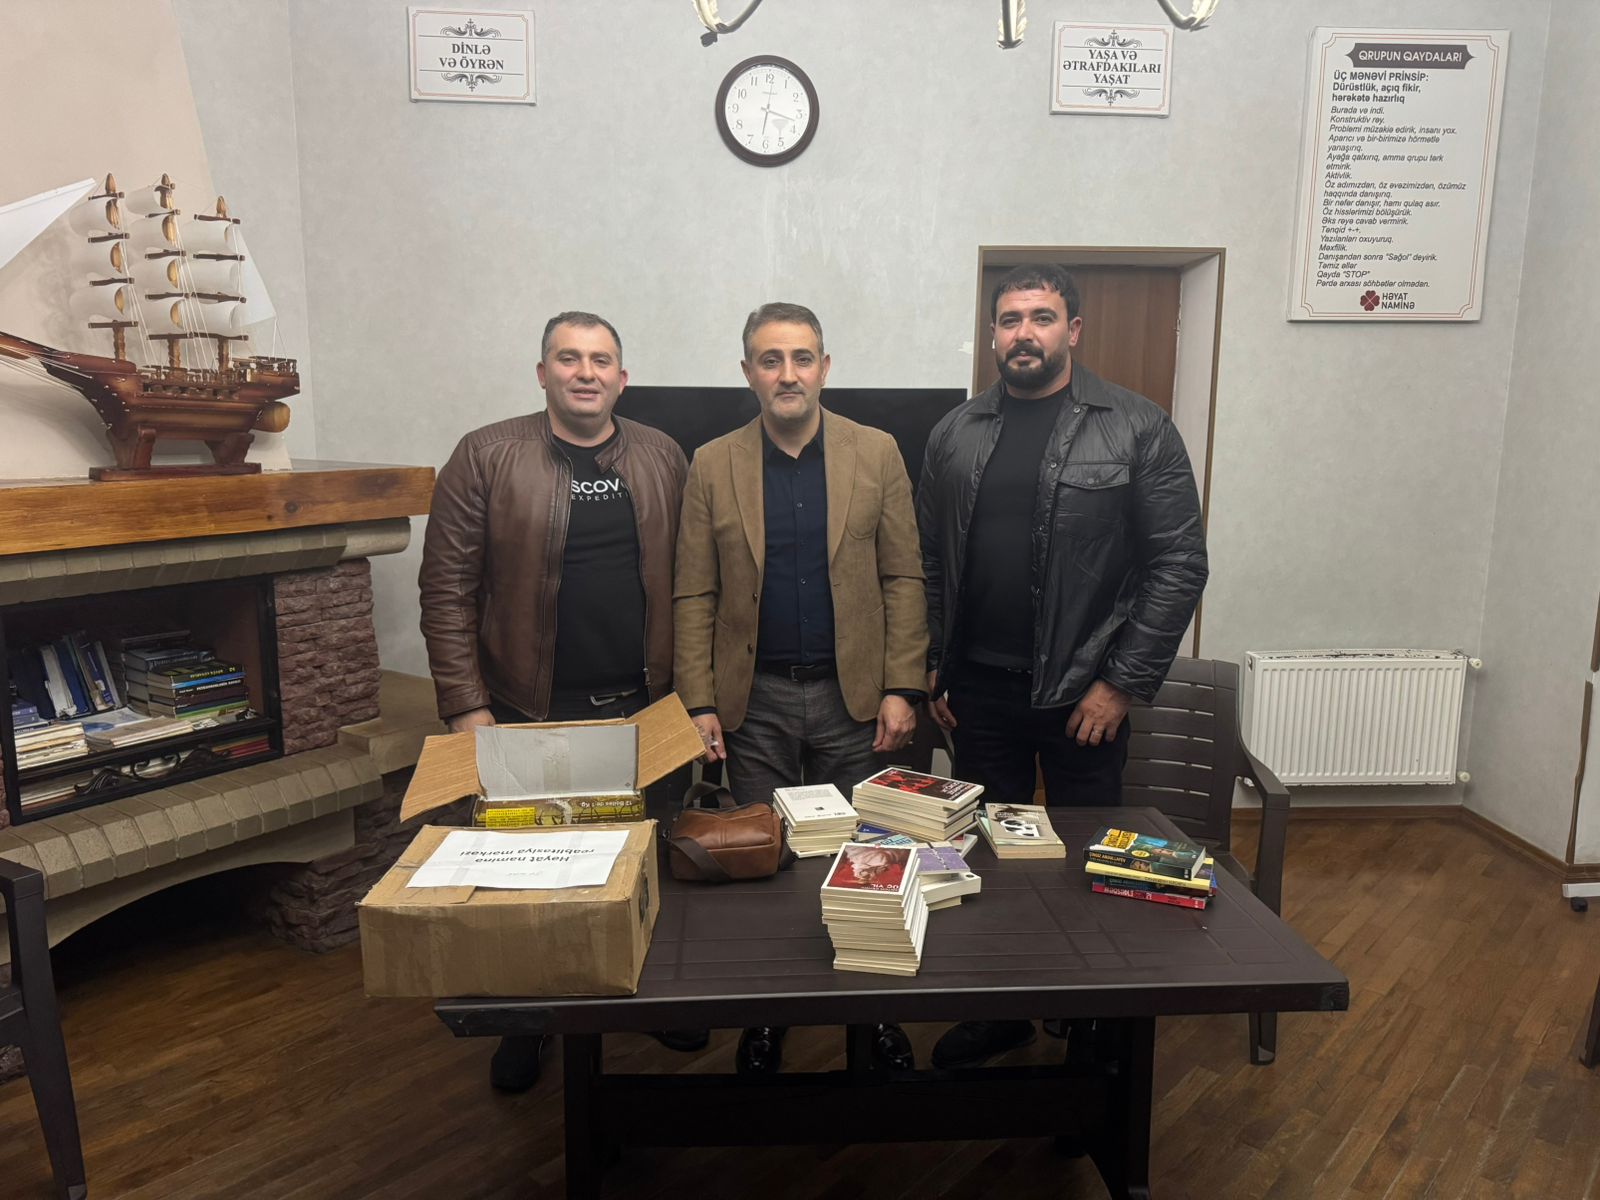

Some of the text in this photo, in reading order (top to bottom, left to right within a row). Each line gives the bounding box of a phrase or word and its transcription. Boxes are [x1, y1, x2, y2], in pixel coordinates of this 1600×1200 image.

[452, 42, 491, 55] DİNLƏ
[1088, 49, 1138, 62] YAŞA VƏ
[1359, 50, 1462, 62] QRUPUN QAYDALARI
[439, 56, 504, 70] VƏ ÖYRƏN
[1062, 61, 1162, 74] ƏTRAFDAKILARI
[750, 76, 758, 86] 11
[766, 73, 775, 84] 12
[1094, 74, 1130, 86] YAŞAT
[1334, 70, 1429, 82] ÜÇ MƏNƏVİ PRİNSİP:
[1333, 82, 1421, 93] Dürüstlük, açıq fikir,
[738, 88, 747, 99] 10
[792, 92, 799, 102] 2
[1332, 94, 1405, 104] hərəkətə hazırlıq
[732, 104, 739, 113] 9
[796, 109, 803, 120] 3
[736, 120, 743, 129] 8
[790, 125, 796, 134] 4
[747, 134, 754, 144] 7
[778, 137, 784, 147] 5
[762, 140, 768, 150] 6
[1381, 301, 1415, 310] NAMİNƏ
[572, 478, 625, 494] SCOV
